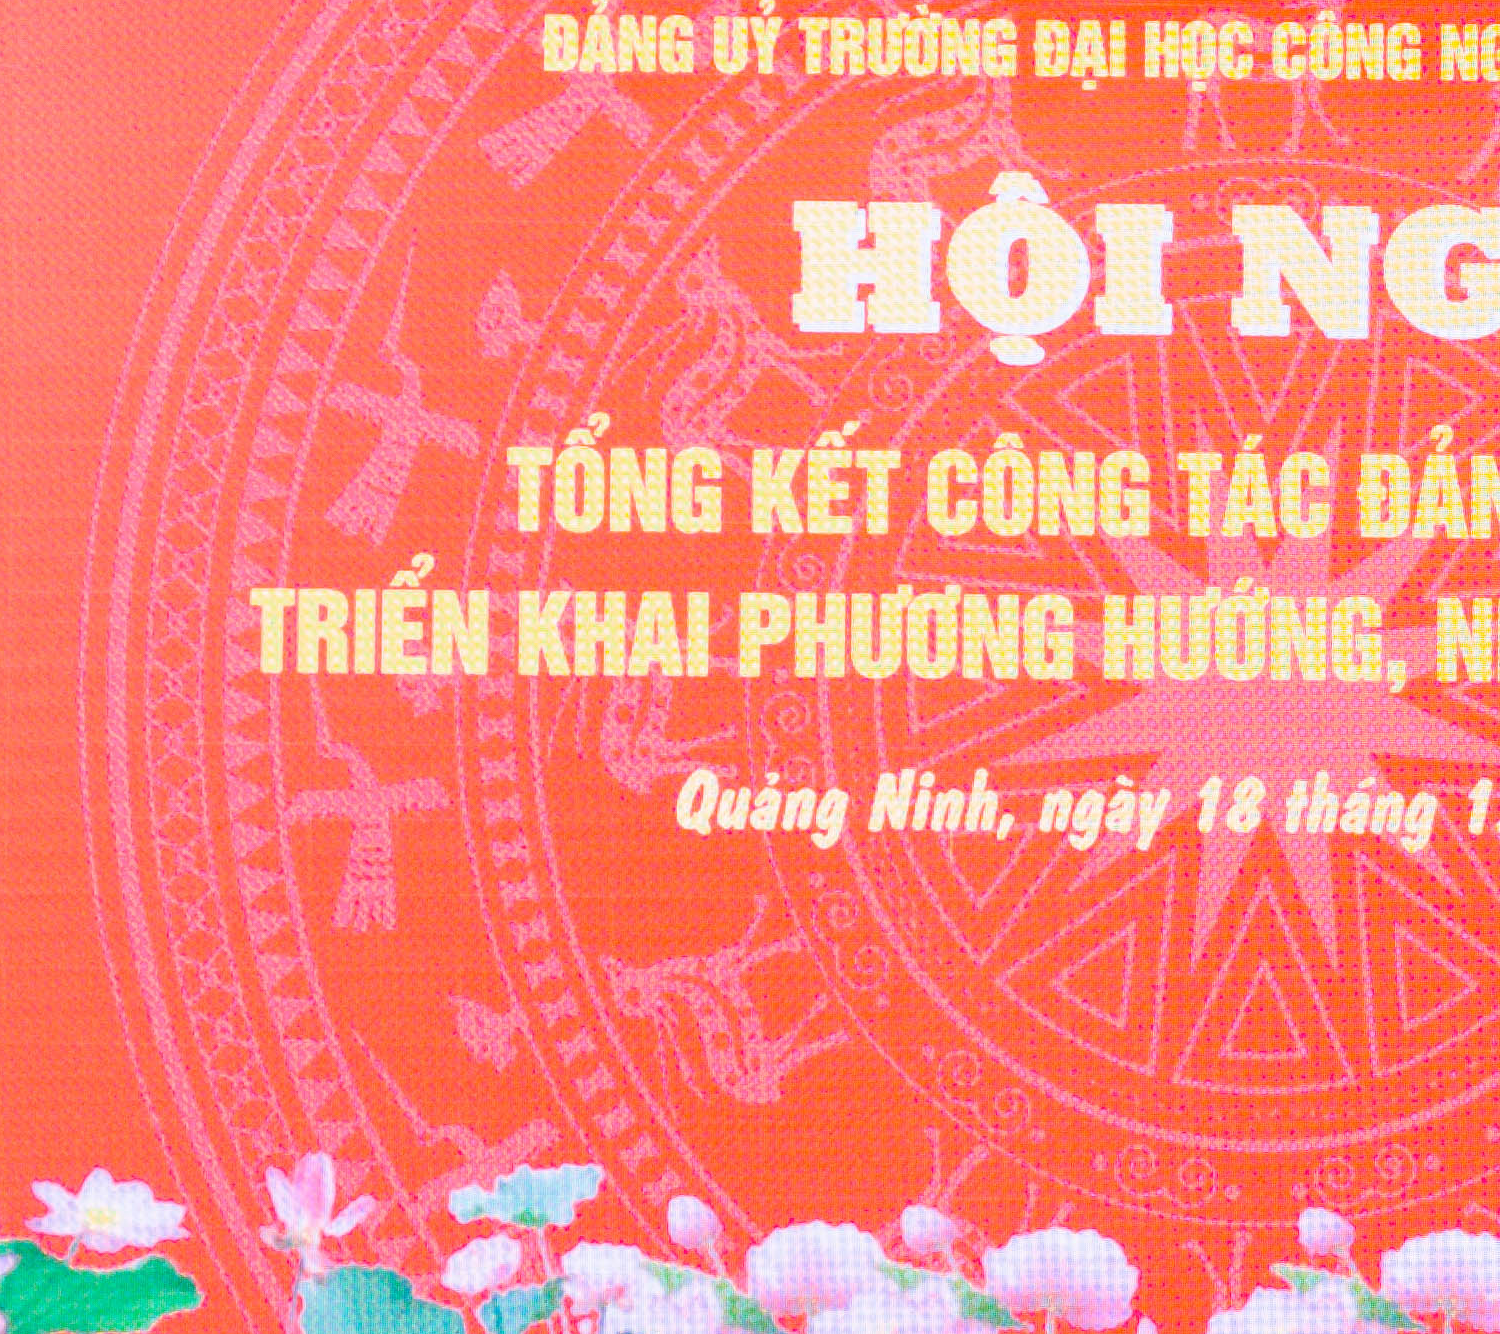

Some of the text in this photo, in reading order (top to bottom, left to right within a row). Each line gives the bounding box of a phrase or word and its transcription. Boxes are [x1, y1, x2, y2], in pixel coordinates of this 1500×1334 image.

[714, 0, 781, 74] UỶ
[800, 5, 1016, 76] TRƯỜNG
[1034, 21, 1125, 89] ĐẠI
[1146, 21, 1252, 91] HỌC
[1273, 11, 1420, 80] CÔNG
[793, 171, 1173, 365] HỘI
[508, 413, 721, 533] TỔNG
[753, 422, 900, 533] KẾT
[928, 433, 1149, 537] CÔNG
[1178, 435, 1330, 538] TÁC
[251, 554, 488, 674] TRIỂN
[519, 591, 708, 676] KHAI
[740, 585, 1073, 679] PHƯƠNG
[1104, 577, 1406, 692] HƯỚNG,
[677, 769, 848, 847] Quảng
[869, 769, 1013, 839] Ninh,
[1040, 776, 1170, 850] ngày
[1199, 776, 1265, 832] 18
[1286, 771, 1437, 852] tháng
